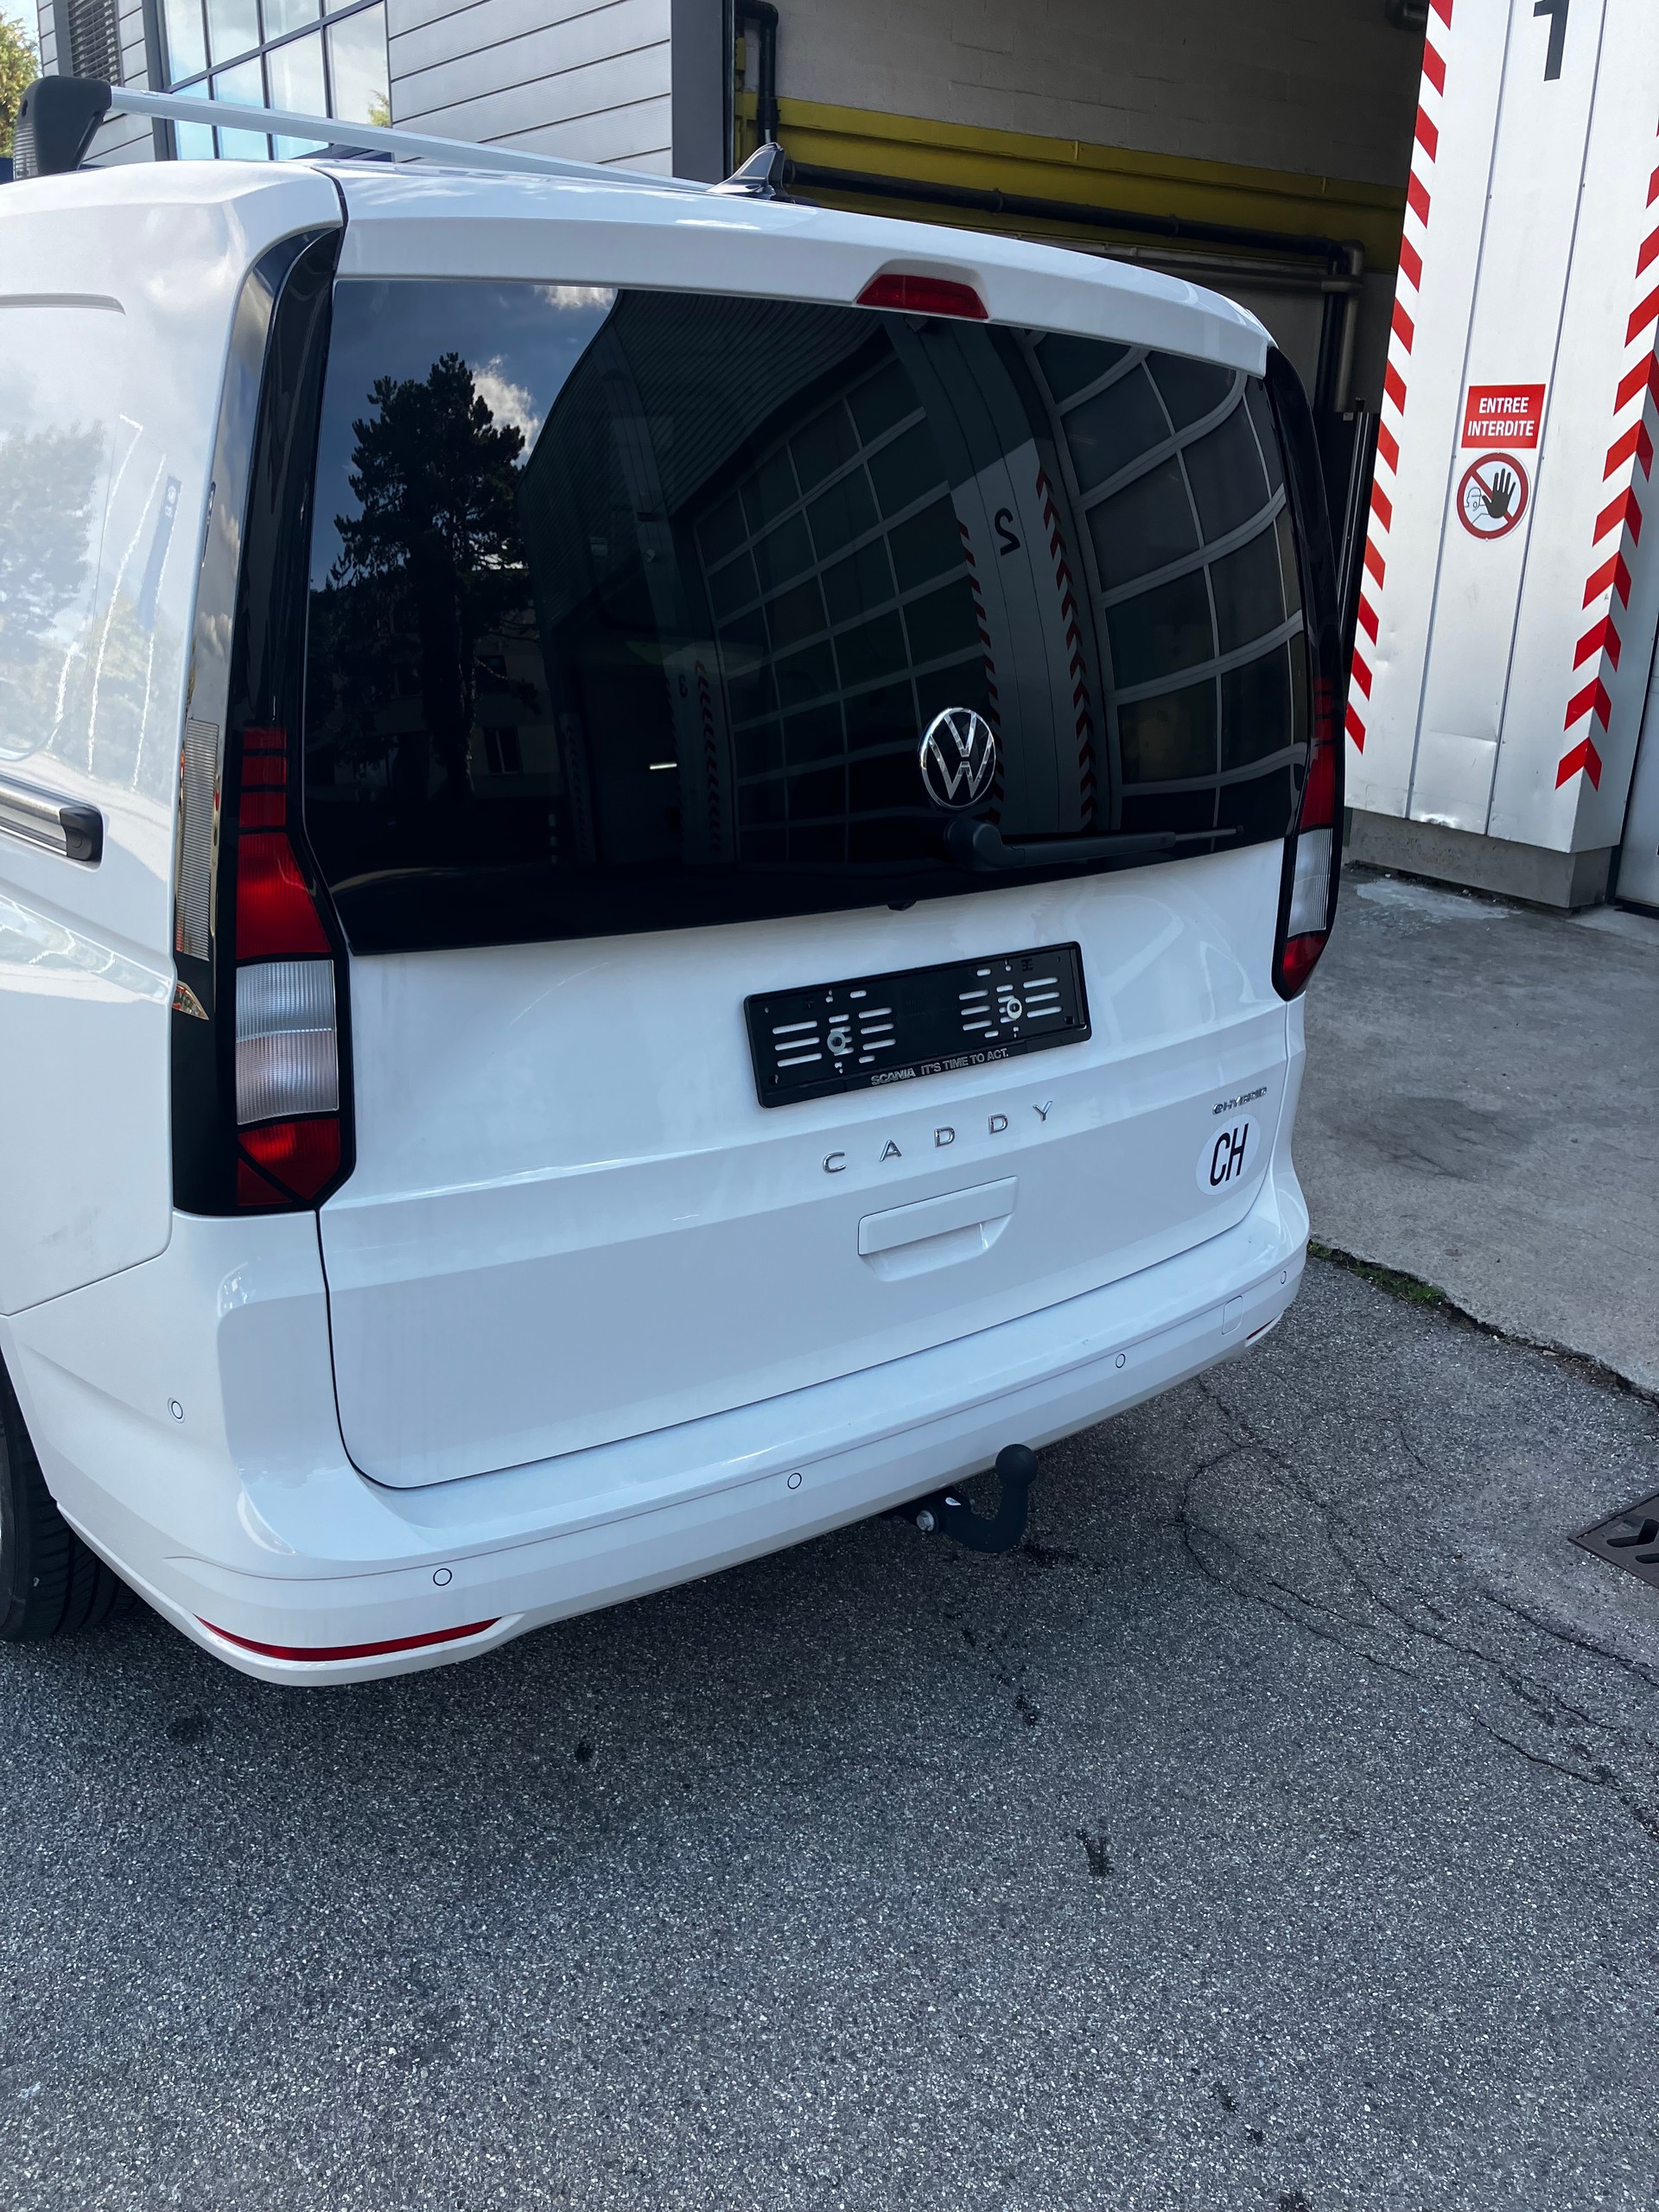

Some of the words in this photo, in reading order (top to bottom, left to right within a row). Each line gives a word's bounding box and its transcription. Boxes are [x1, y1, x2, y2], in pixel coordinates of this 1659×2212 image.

[1533, 0, 1570, 81] 1
[1467, 419, 1535, 439] INTERDITE
[1478, 396, 1529, 416] ENTREE
[870, 1067, 917, 1086] SCANIA
[920, 1063, 942, 1076] IT'S
[942, 1057, 969, 1070] TIME
[969, 1052, 985, 1065] TO
[987, 1047, 1010, 1062] ACT.
[822, 1100, 1054, 1173] CADDY
[1210, 1122, 1249, 1186] CH
